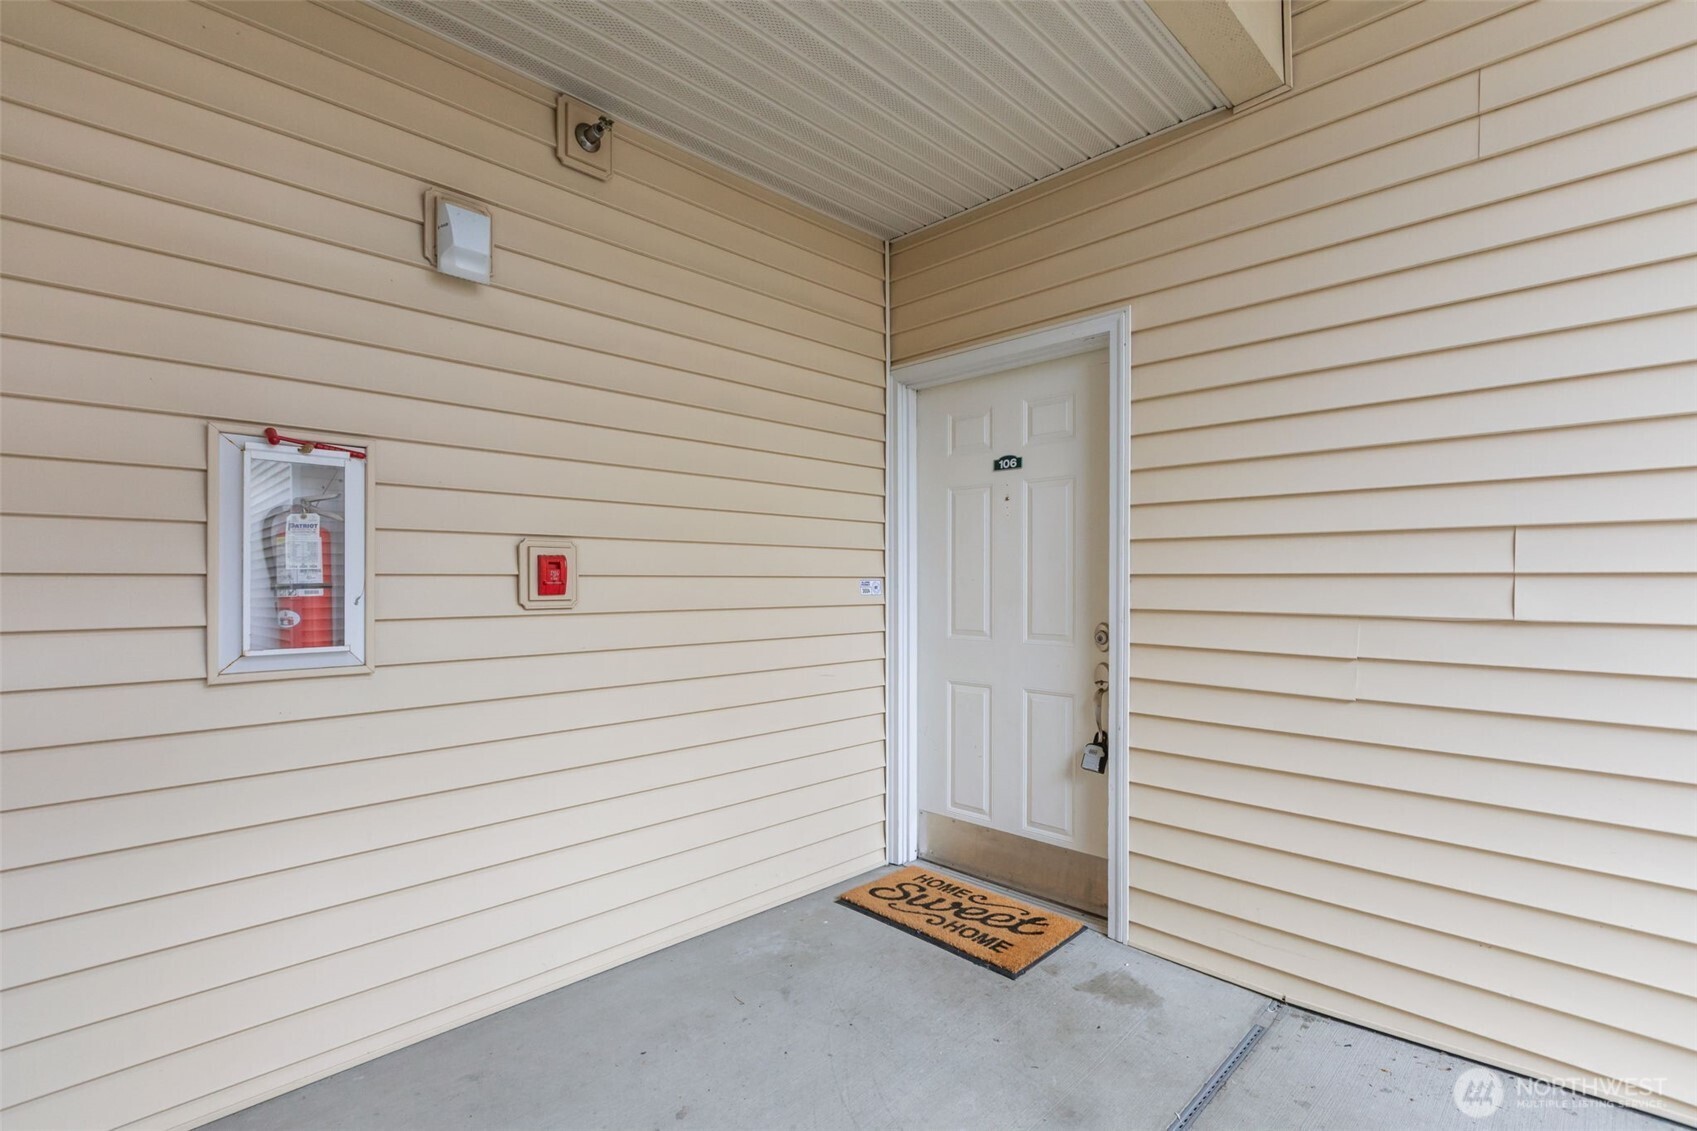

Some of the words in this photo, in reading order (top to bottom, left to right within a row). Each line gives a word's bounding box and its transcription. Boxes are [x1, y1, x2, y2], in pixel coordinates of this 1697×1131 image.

[999, 458, 1017, 469] 106
[913, 874, 972, 898] HOME
[868, 882, 1049, 935] Sweet
[943, 921, 1014, 953] HOME
